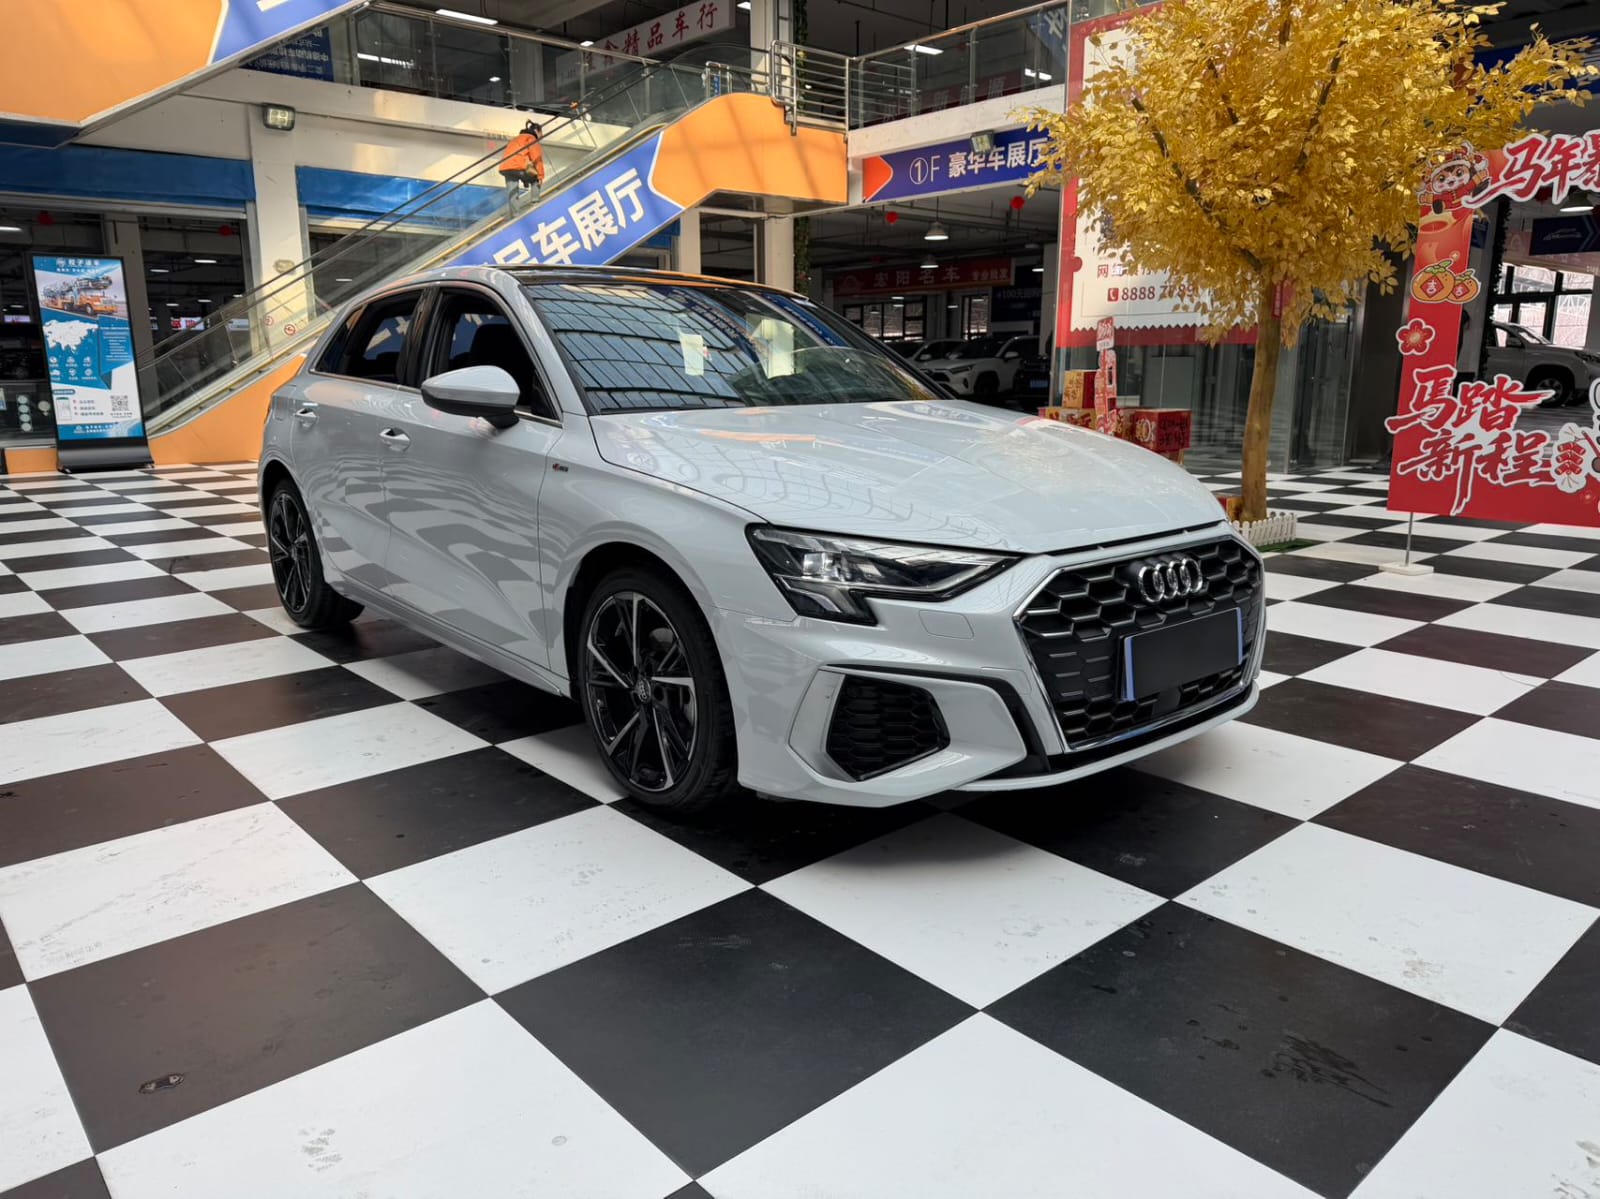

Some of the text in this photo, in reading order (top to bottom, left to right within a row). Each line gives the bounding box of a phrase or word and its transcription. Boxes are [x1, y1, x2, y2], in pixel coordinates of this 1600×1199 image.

[583, 3, 718, 70] 精品车行
[1121, 286, 1156, 301] 8888
